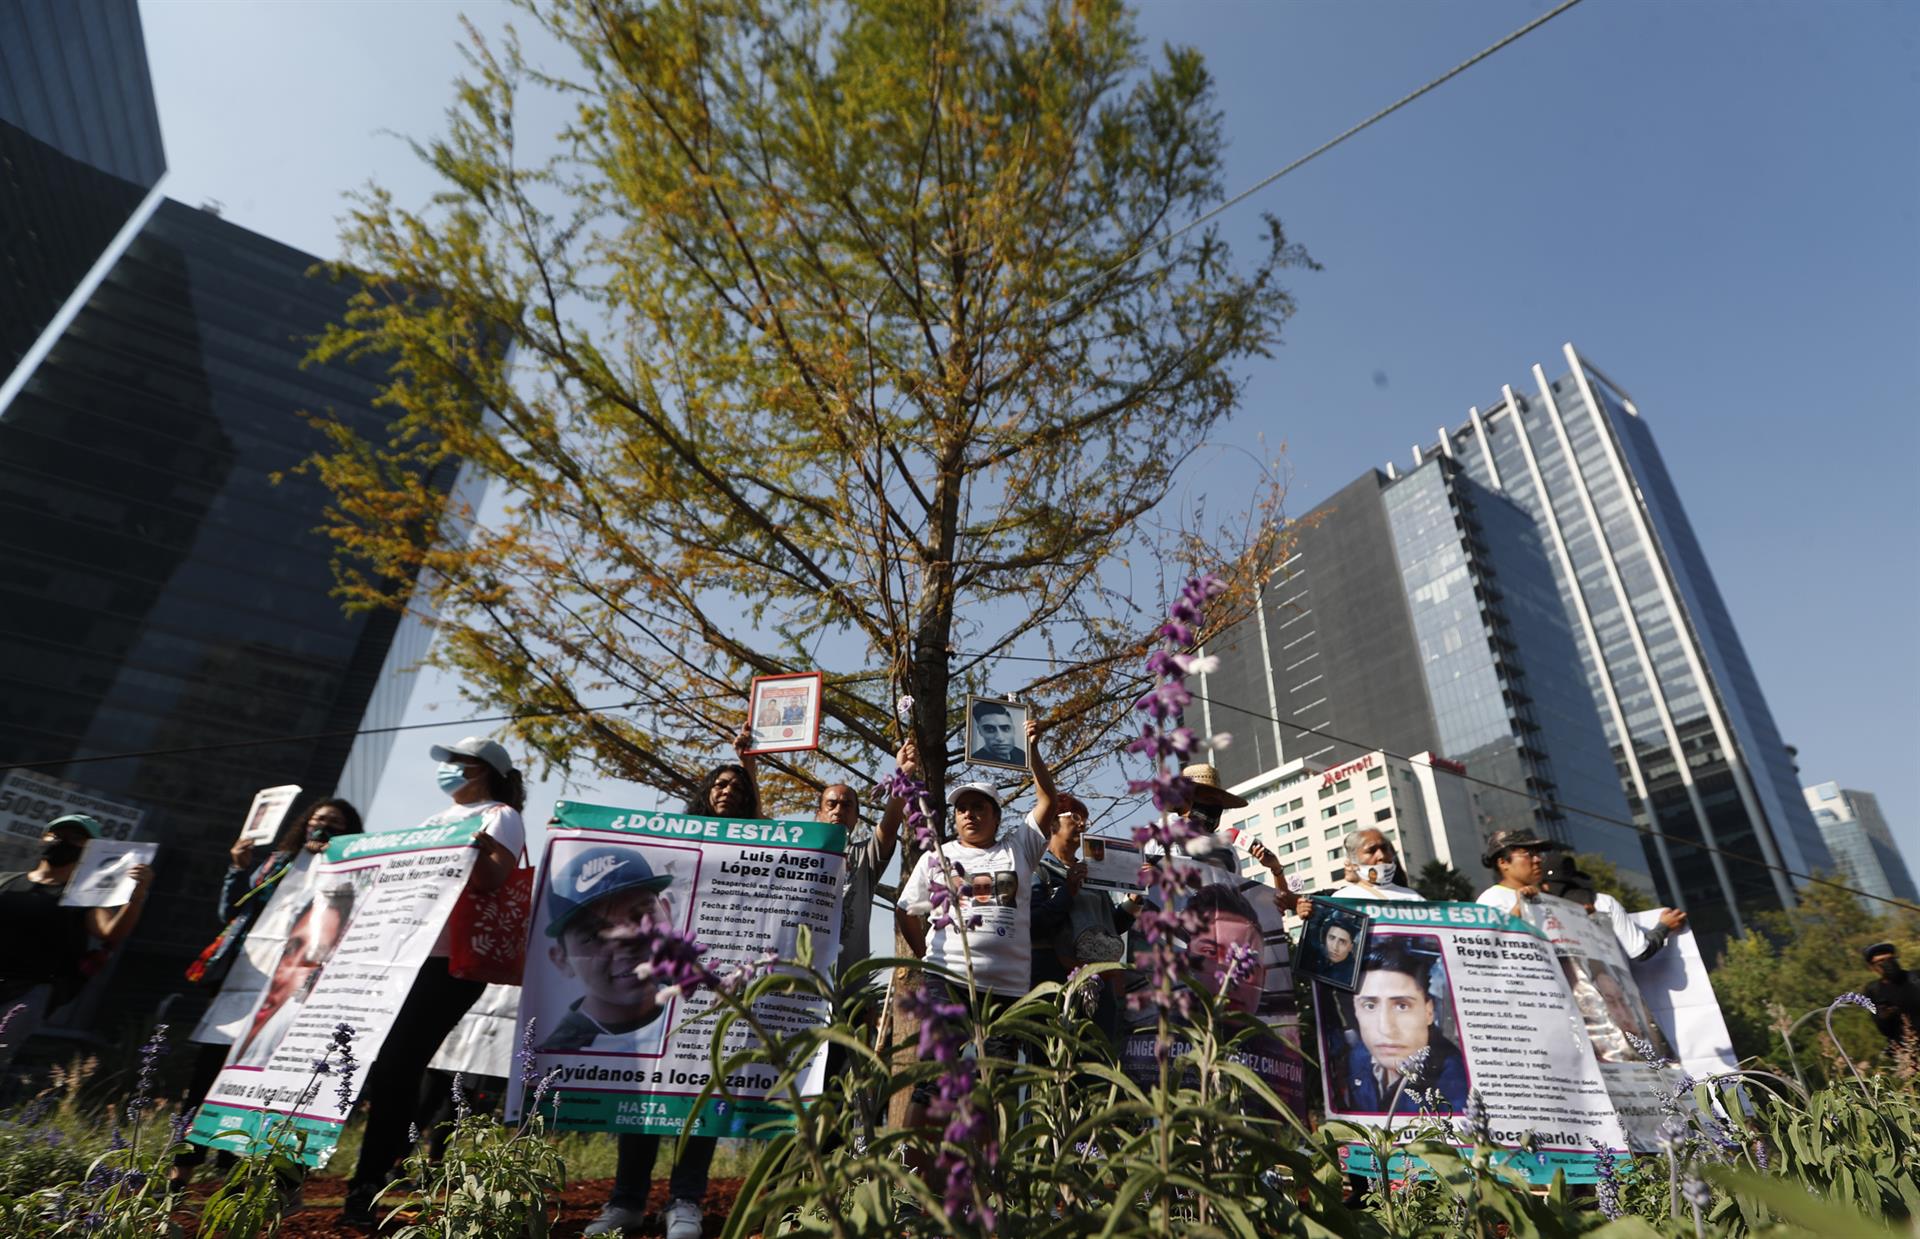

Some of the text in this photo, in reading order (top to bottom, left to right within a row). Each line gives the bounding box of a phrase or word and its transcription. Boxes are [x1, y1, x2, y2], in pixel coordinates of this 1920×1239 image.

[1322, 756, 1373, 789] Marriott
[611, 812, 804, 844] ¿DÓNDE ESTÁ?
[739, 849, 826, 870] Luis Ángel
[407, 867, 463, 880] Herndez
[581, 855, 615, 880] NIKE
[720, 860, 837, 886] López Guzmán
[711, 878, 757, 889] Desapareció
[769, 883, 797, 892] Colonia
[799, 886, 808, 894] La
[701, 901, 728, 911] Fecha:
[729, 903, 741, 911] 26
[742, 904, 752, 912] de
[754, 905, 799, 917] septiembre
[800, 910, 810, 918] de
[699, 914, 722, 923] Sexo:
[723, 915, 756, 925] Hombre
[814, 926, 831, 935] años
[697, 927, 771, 940] Estatura: 1.75 mts
[1452, 934, 1491, 948] Jesús
[1456, 946, 1498, 961] Reyes
[1459, 985, 1482, 993] Fecha:
[1518, 1000, 1536, 1008] Edad:
[758, 1013, 786, 1021] nombre
[1464, 1010, 1495, 1018] Estatura:
[1485, 1034, 1512, 1042] Morena
[1126, 1036, 1157, 1057] ÁNGE
[1472, 1046, 1490, 1054] Ojos:
[674, 1053, 699, 1062] verde,
[651, 1072, 663, 1084] a
[669, 1069, 778, 1090] locazarlo!
[1477, 1072, 1497, 1080] Señas
[1500, 1073, 1541, 1081] particulares:
[1504, 1091, 1532, 1099] superior
[617, 1101, 667, 1114] HASTA
[616, 1115, 701, 1128] ENCONTRARS
[1490, 1127, 1582, 1146] ocaarlo!
